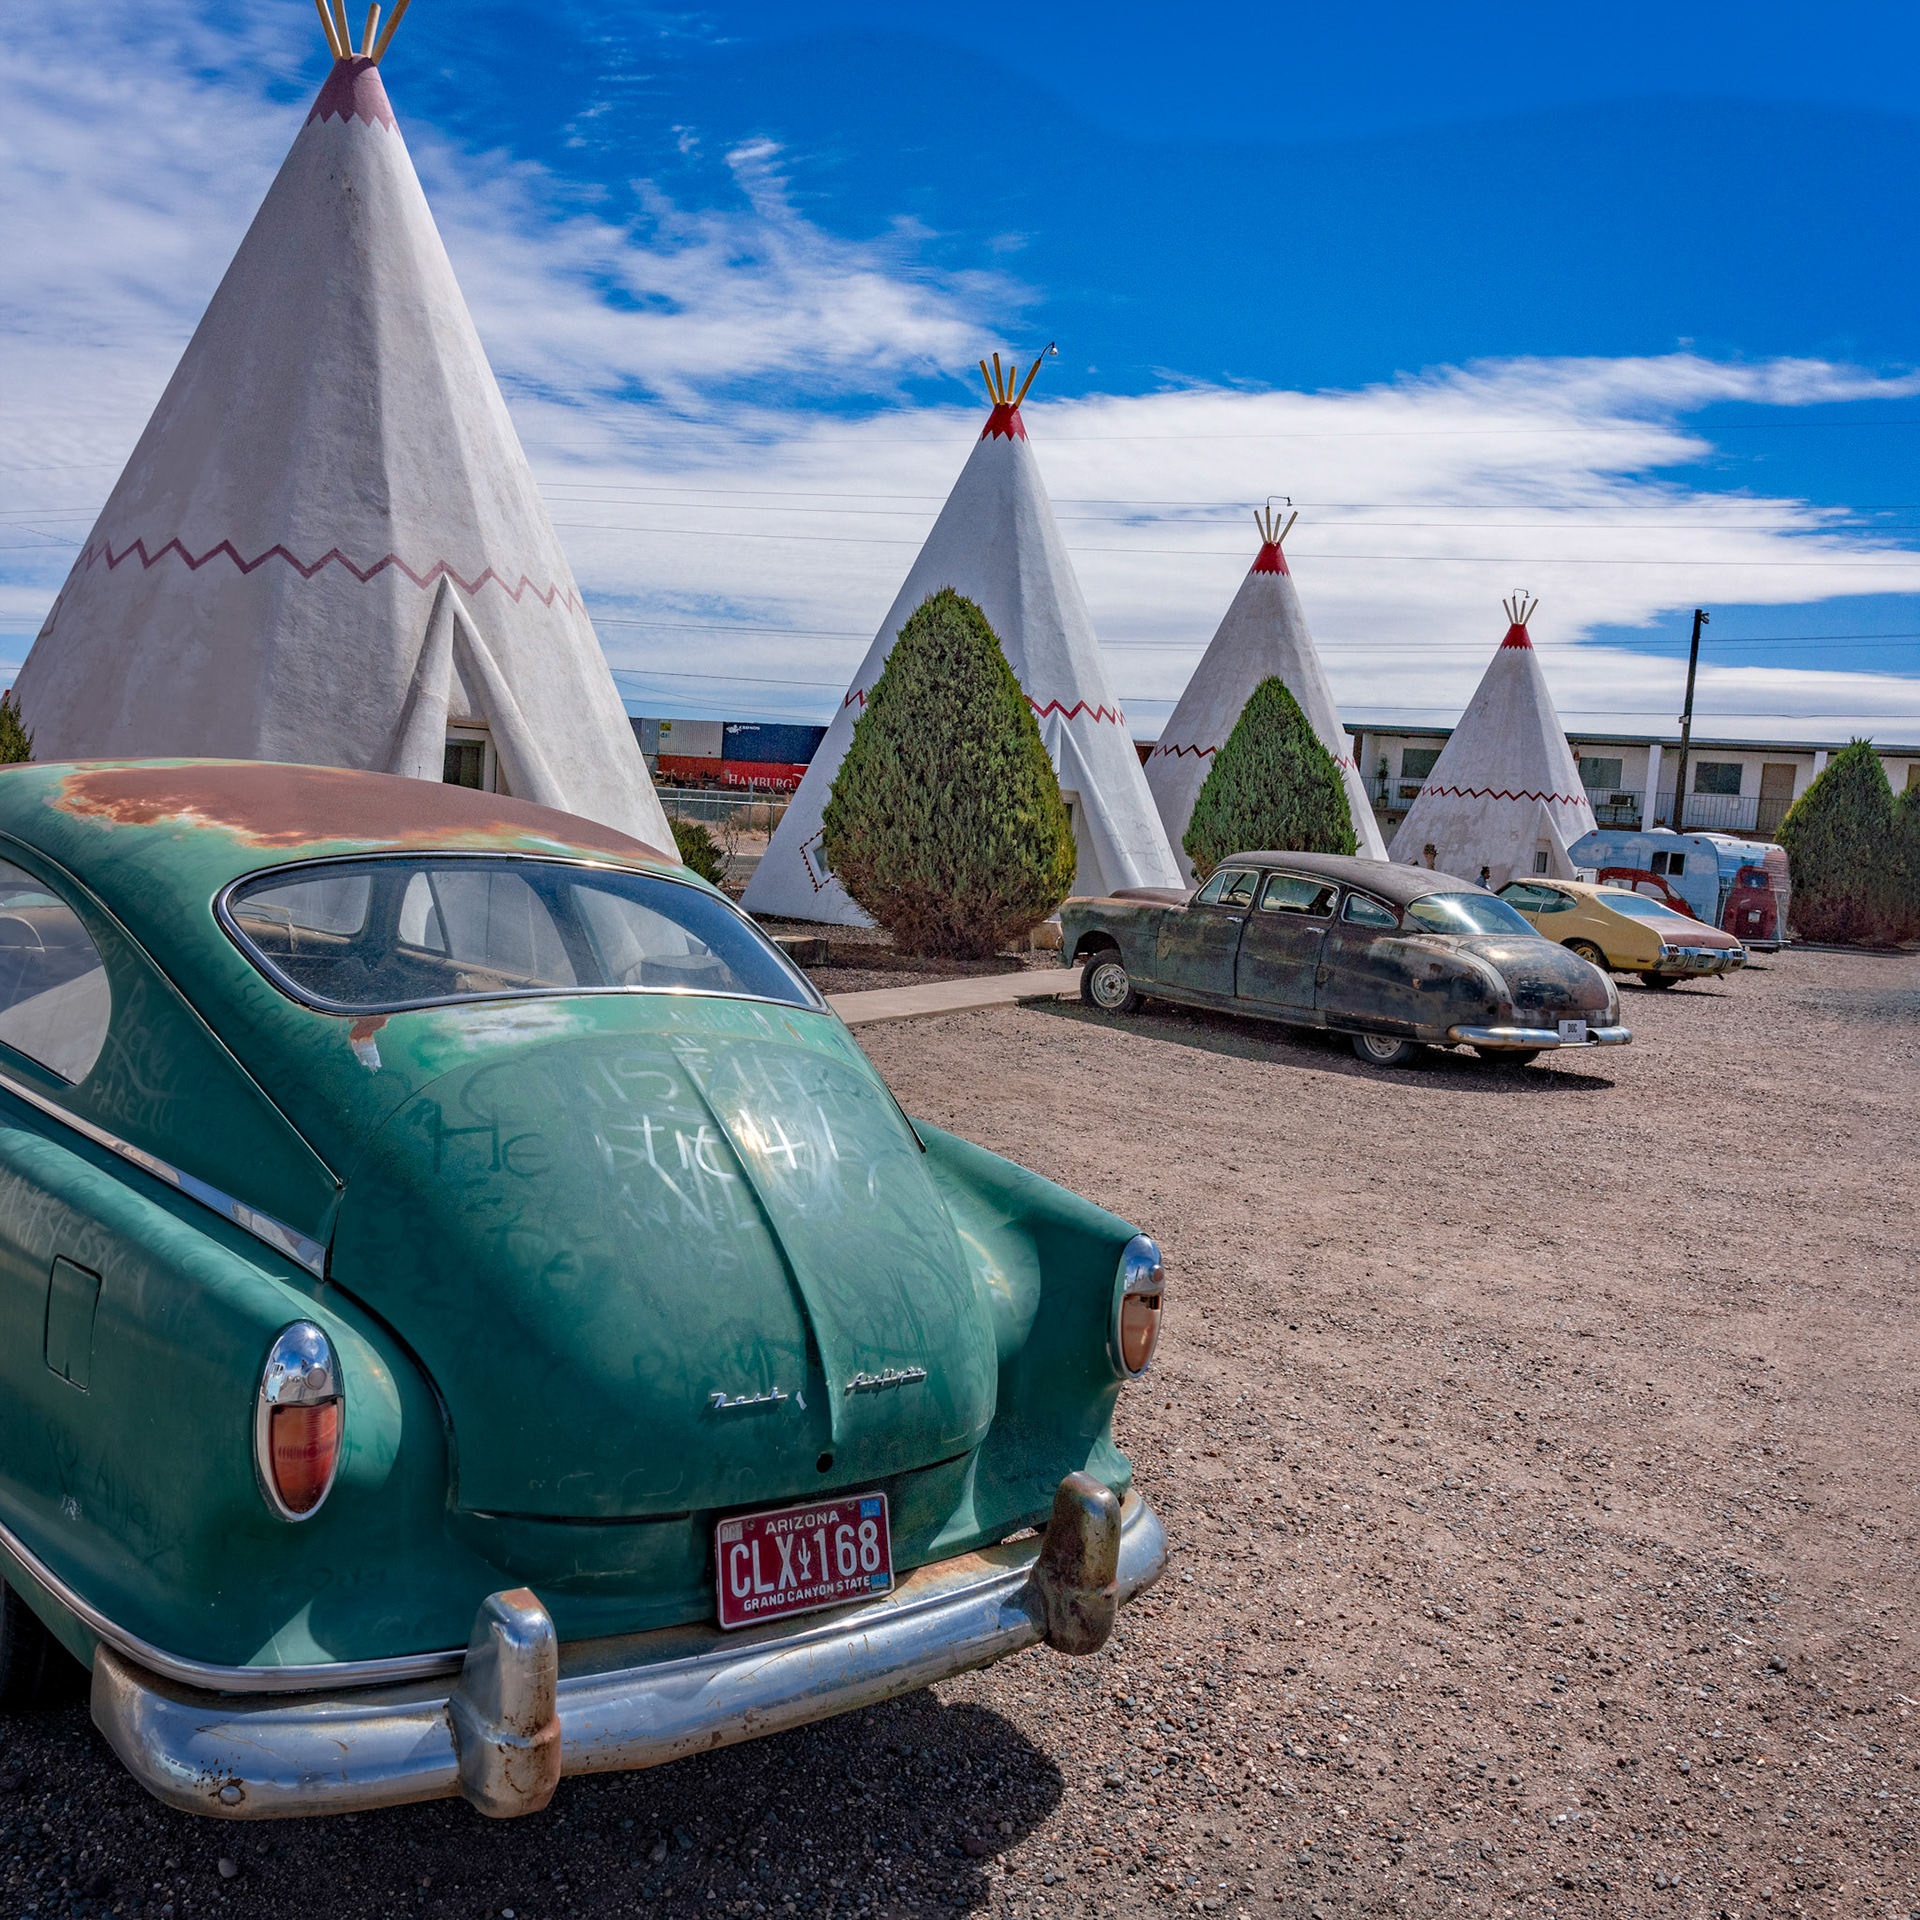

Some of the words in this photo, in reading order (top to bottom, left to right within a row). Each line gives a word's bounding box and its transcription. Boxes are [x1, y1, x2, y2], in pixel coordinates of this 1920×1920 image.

[728, 774, 793, 789] HAMBURG
[711, 1386, 788, 1409] Nash
[765, 1510, 840, 1535] ARIZONA
[729, 1534, 799, 1598] CLX
[813, 1519, 881, 1582] 168
[743, 1593, 785, 1612] GRAND
[786, 1584, 834, 1602] CANYON
[836, 1576, 870, 1593] STATE
